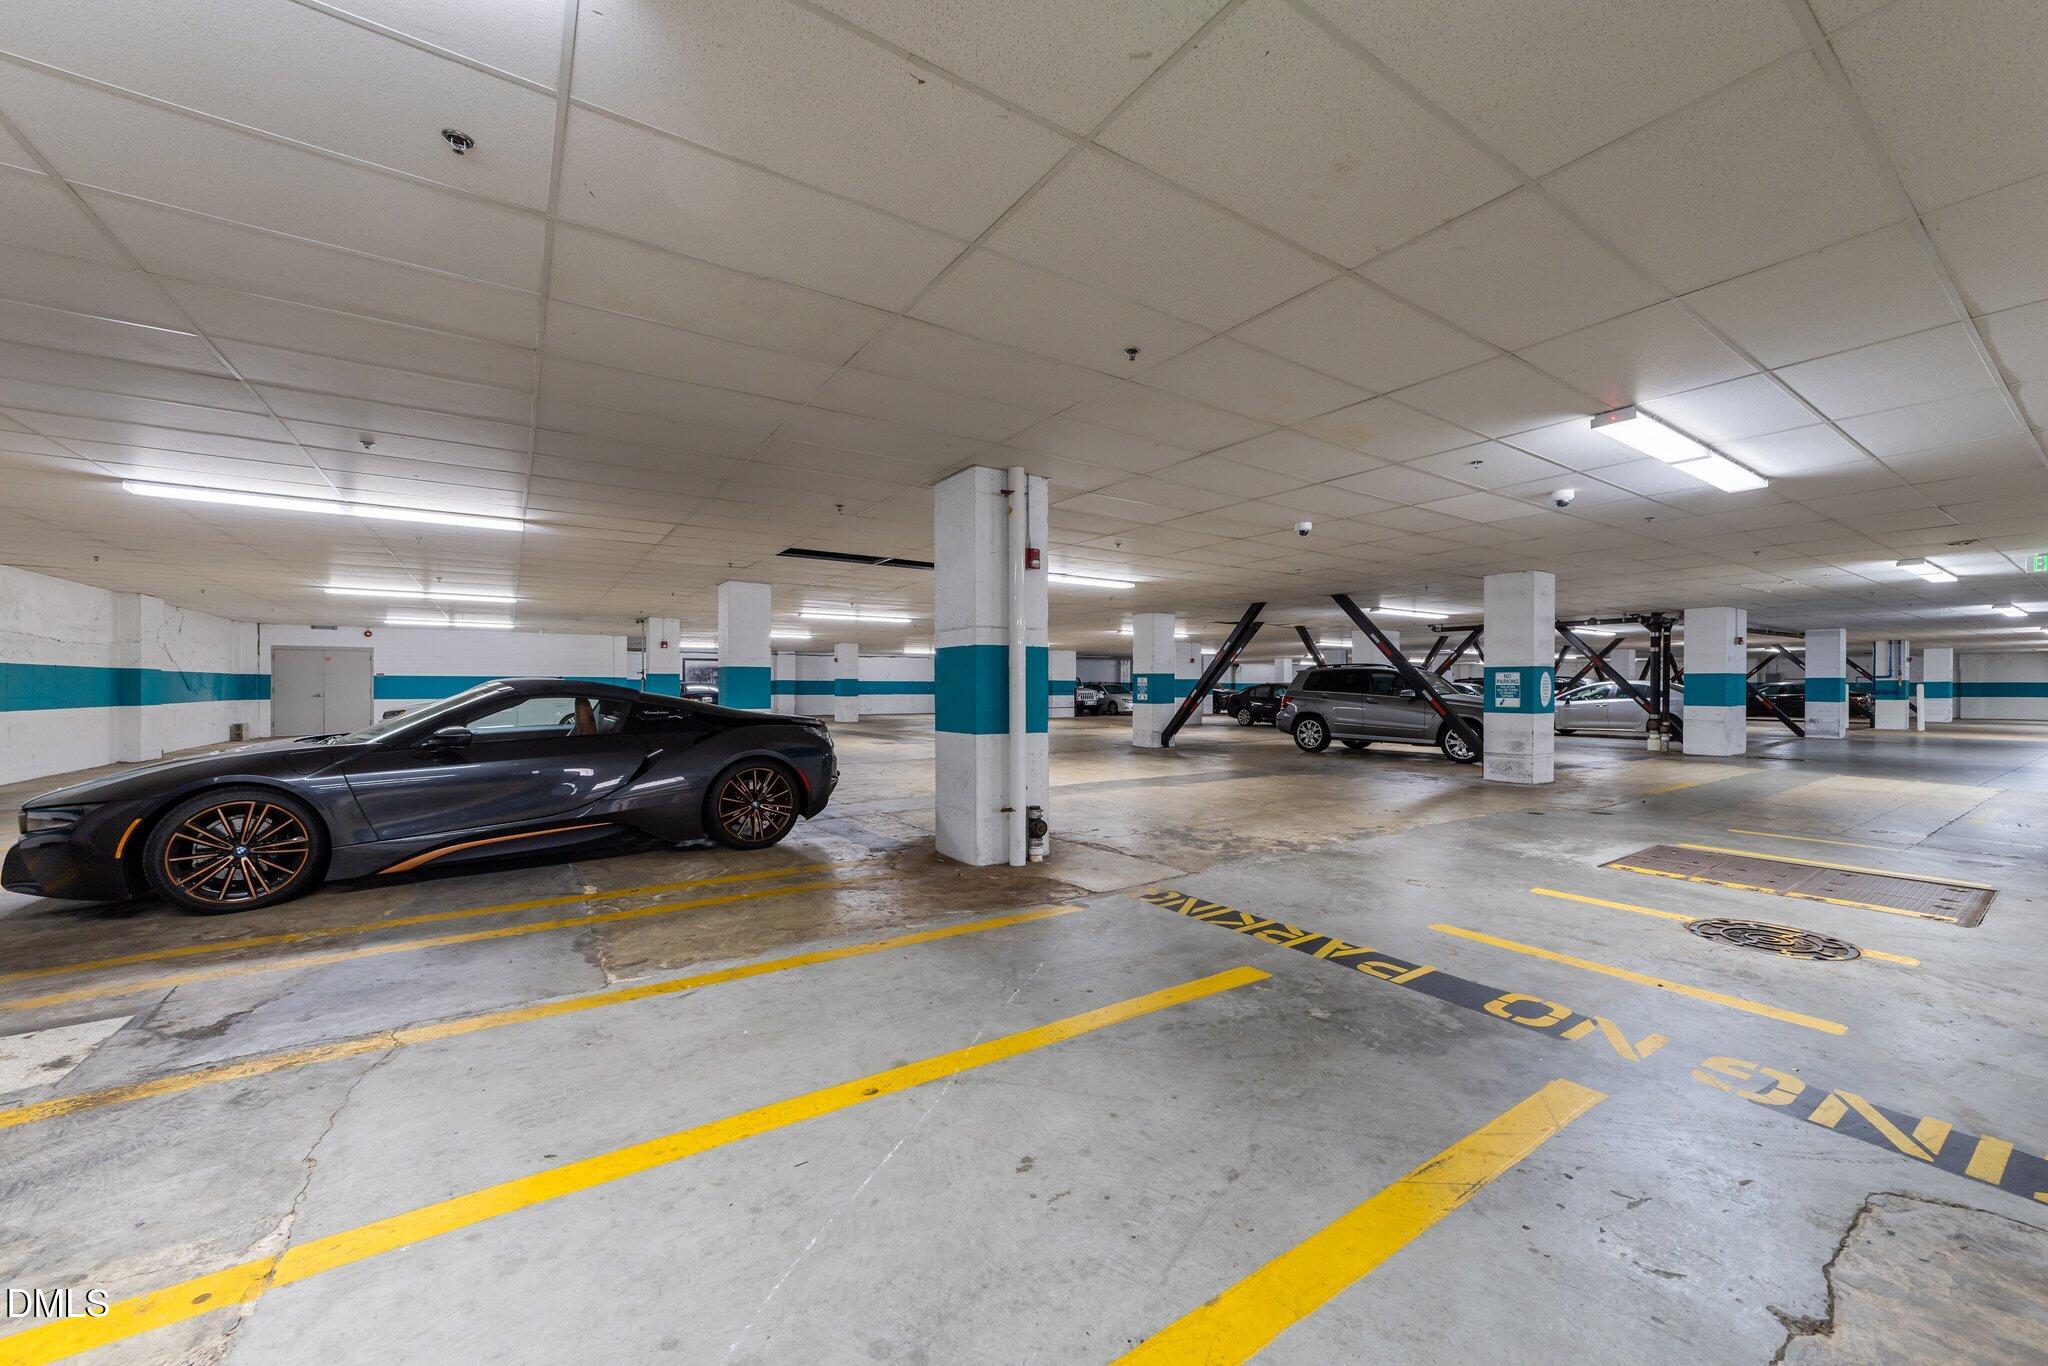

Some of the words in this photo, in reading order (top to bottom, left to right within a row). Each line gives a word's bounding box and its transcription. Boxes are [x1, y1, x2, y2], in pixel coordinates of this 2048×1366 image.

[1132, 887, 1437, 984] PARKING
[1483, 993, 1671, 1061] NO
[1690, 1056, 2048, 1204] ING
